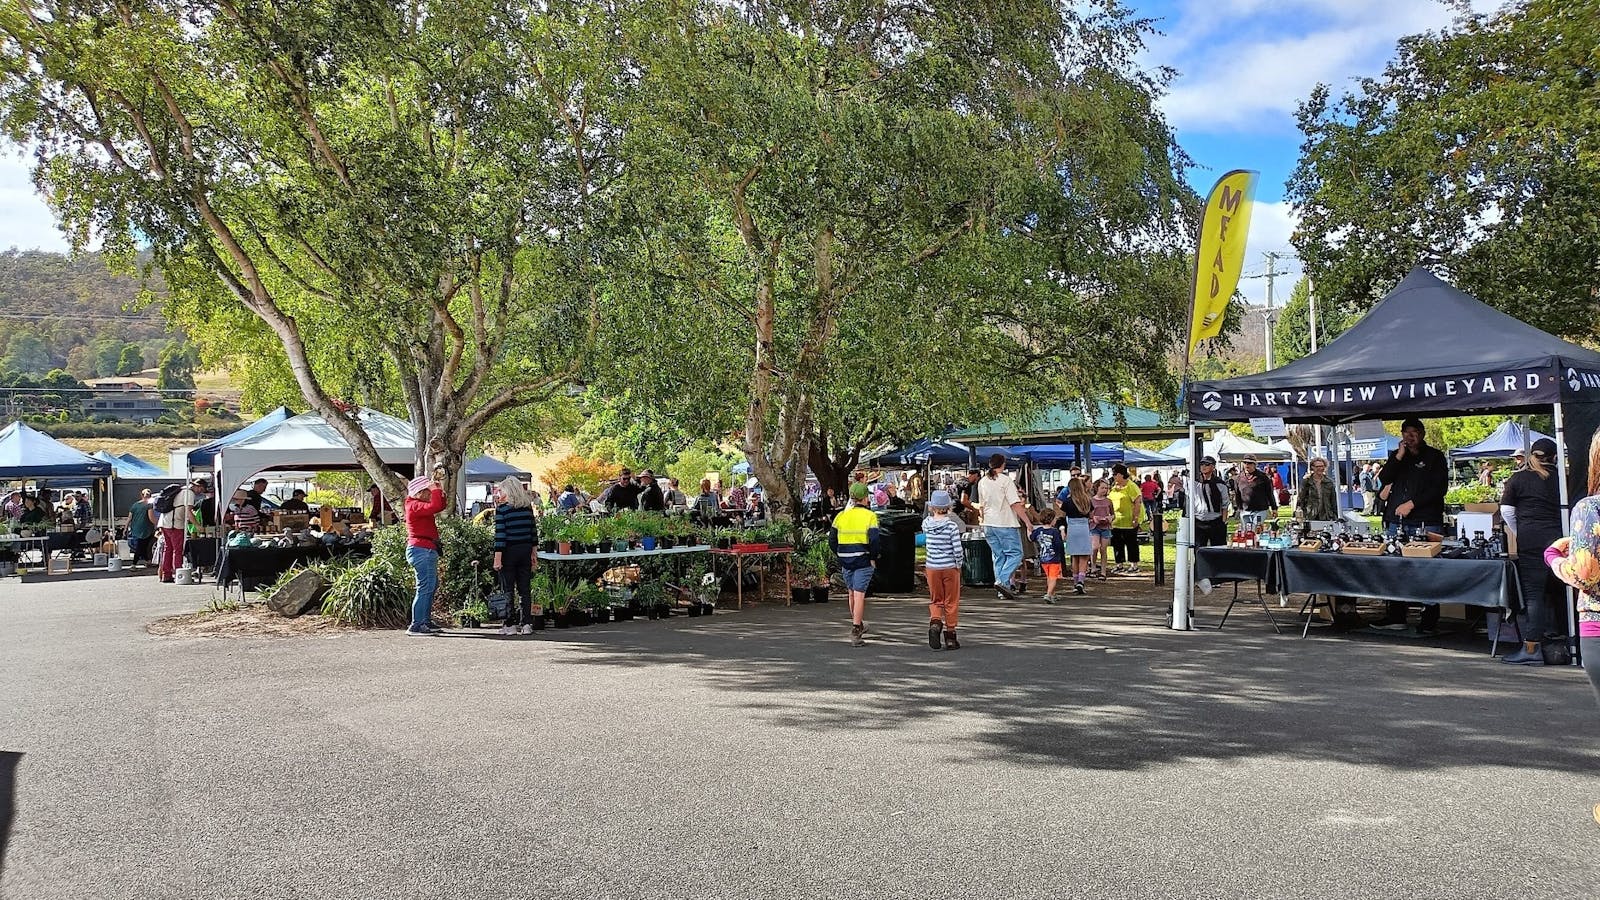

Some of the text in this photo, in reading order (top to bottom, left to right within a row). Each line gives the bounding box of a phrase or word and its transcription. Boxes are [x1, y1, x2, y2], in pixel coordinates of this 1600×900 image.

[1210, 185, 1242, 298] MEAD
[1233, 373, 1540, 407] HARTZVIEW VINEYARD
[1580, 372, 1600, 388] HAR
